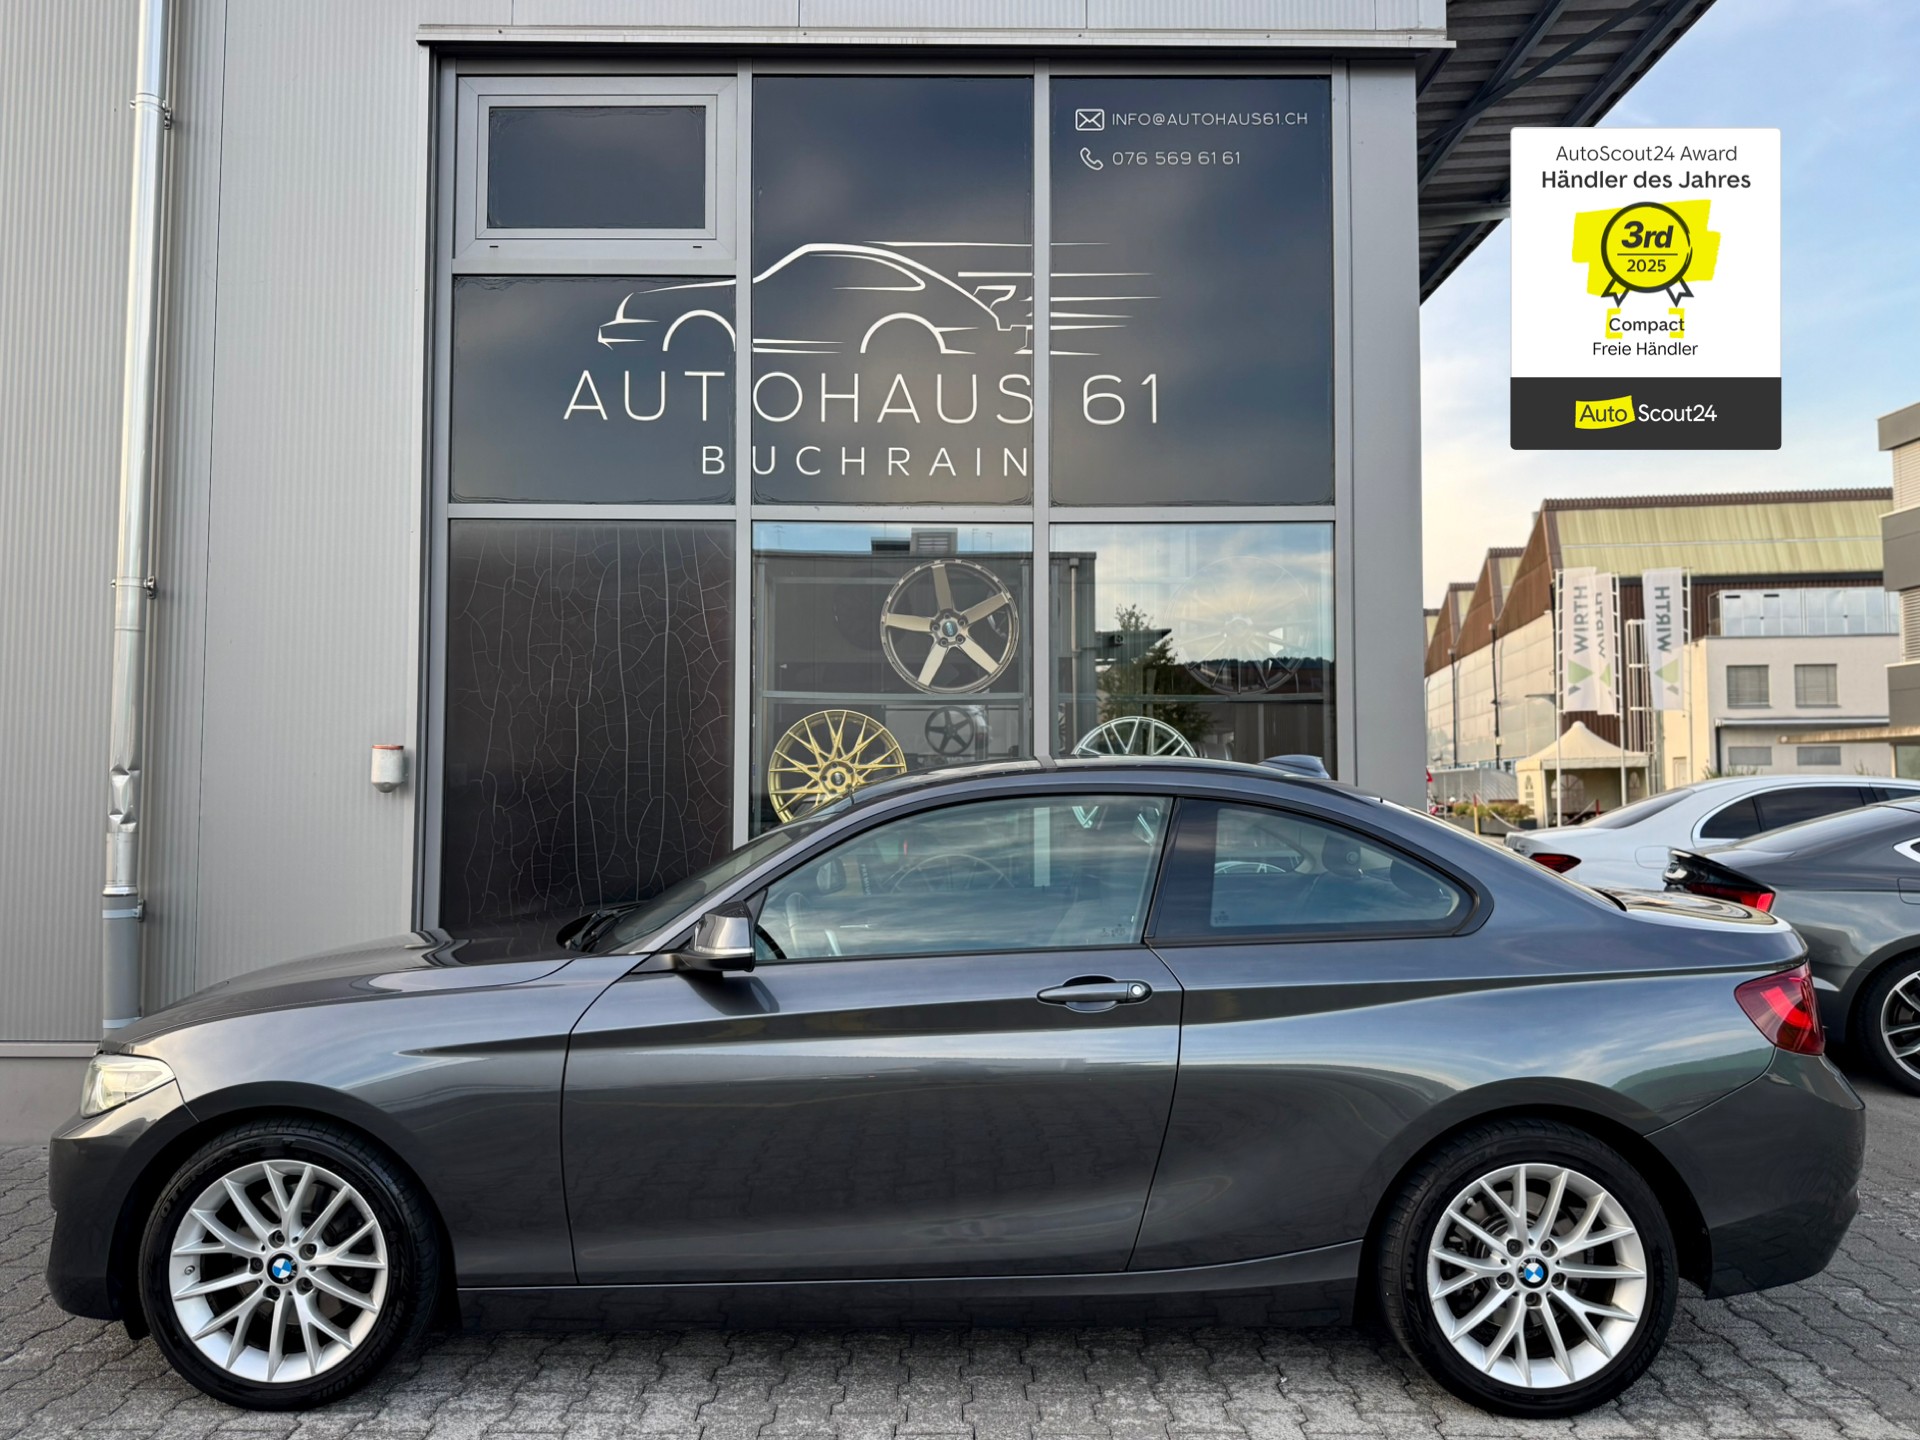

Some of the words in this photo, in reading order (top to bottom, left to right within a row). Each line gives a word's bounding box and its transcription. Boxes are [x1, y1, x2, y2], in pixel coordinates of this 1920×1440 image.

[1112, 112, 1308, 126] INFO@AUTOHAUS61.CH
[1112, 151, 1148, 166] 076
[1155, 151, 1192, 166] 569
[1197, 151, 1217, 165] 61
[1222, 151, 1241, 165] 61
[563, 369, 1034, 425] AUTOHAUS
[1082, 373, 1158, 426] 61
[702, 444, 1028, 477] BUCHRAIN
[1573, 585, 1589, 655] WIRTH
